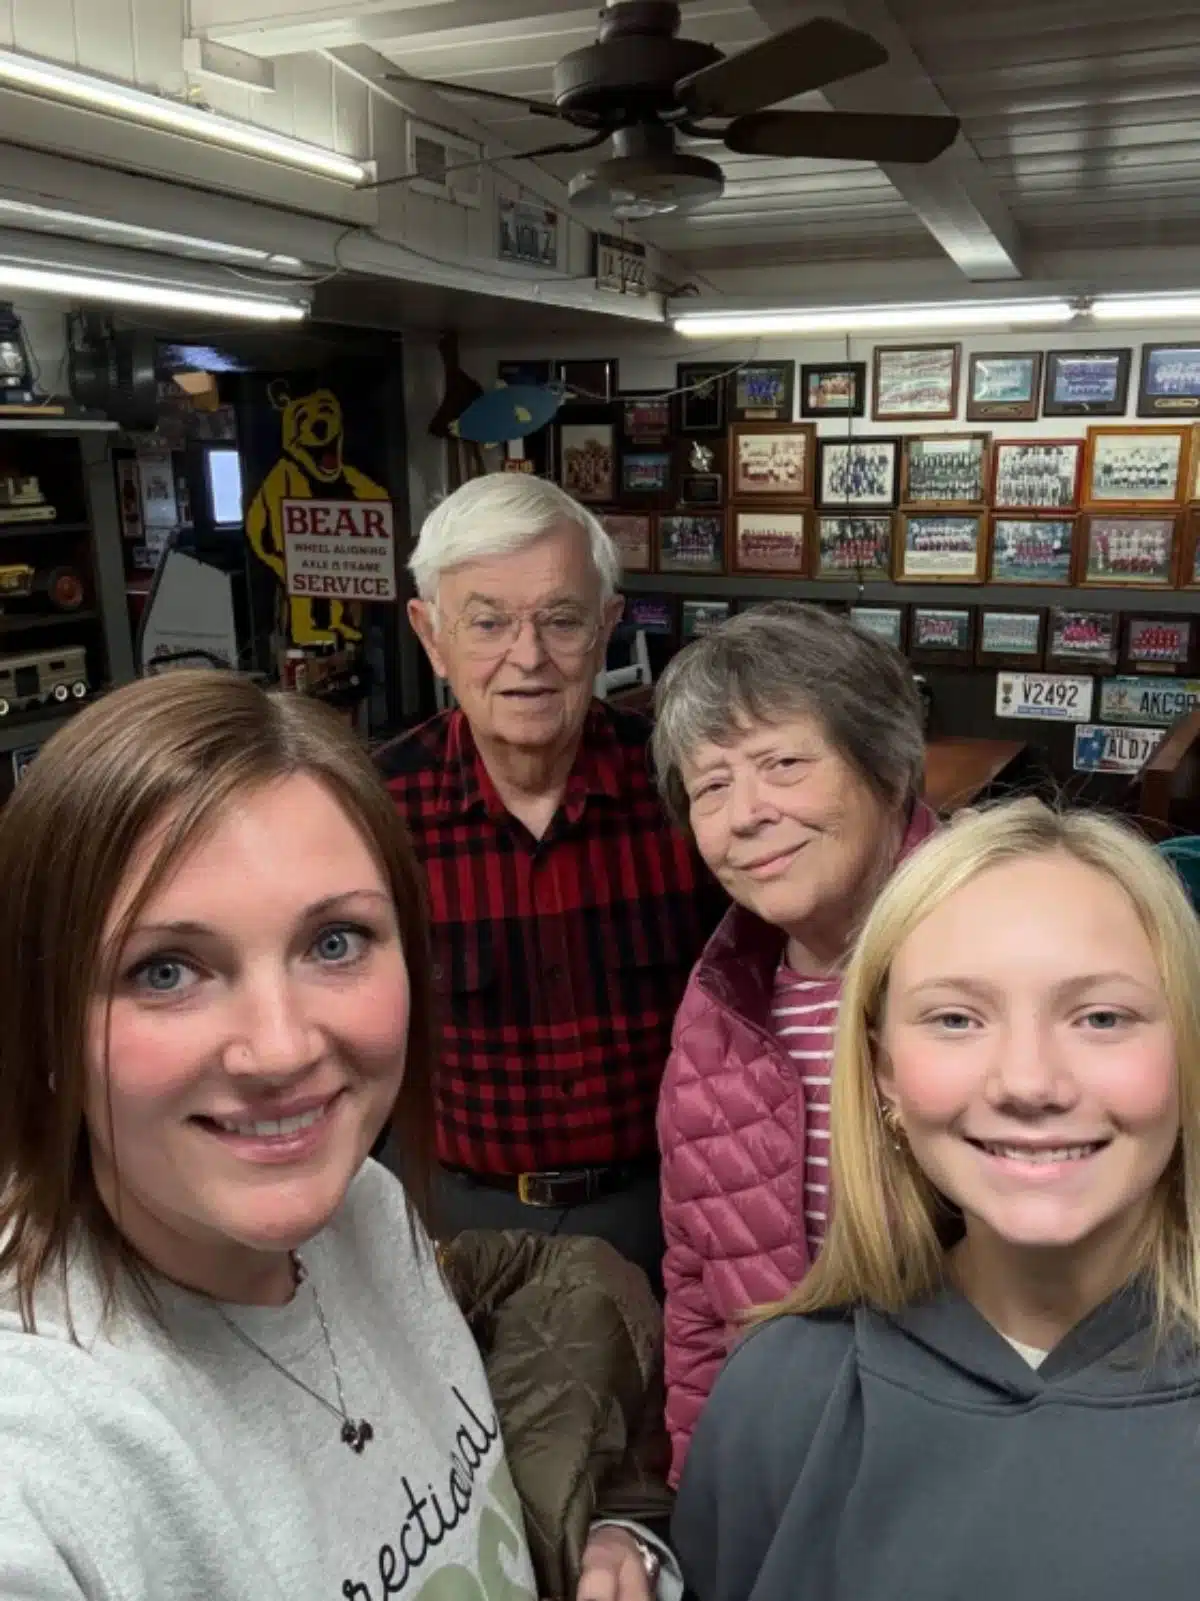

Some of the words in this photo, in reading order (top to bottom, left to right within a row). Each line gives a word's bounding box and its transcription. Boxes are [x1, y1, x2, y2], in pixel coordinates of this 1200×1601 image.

[285, 506, 390, 538] BEAR
[294, 543, 330, 554] WHEEL
[333, 544, 387, 556] ALIGNING
[302, 559, 328, 569] AXLE
[293, 574, 389, 596] SERVICE
[1023, 682, 1079, 707] V2492
[1107, 739, 1159, 760] ALD7
